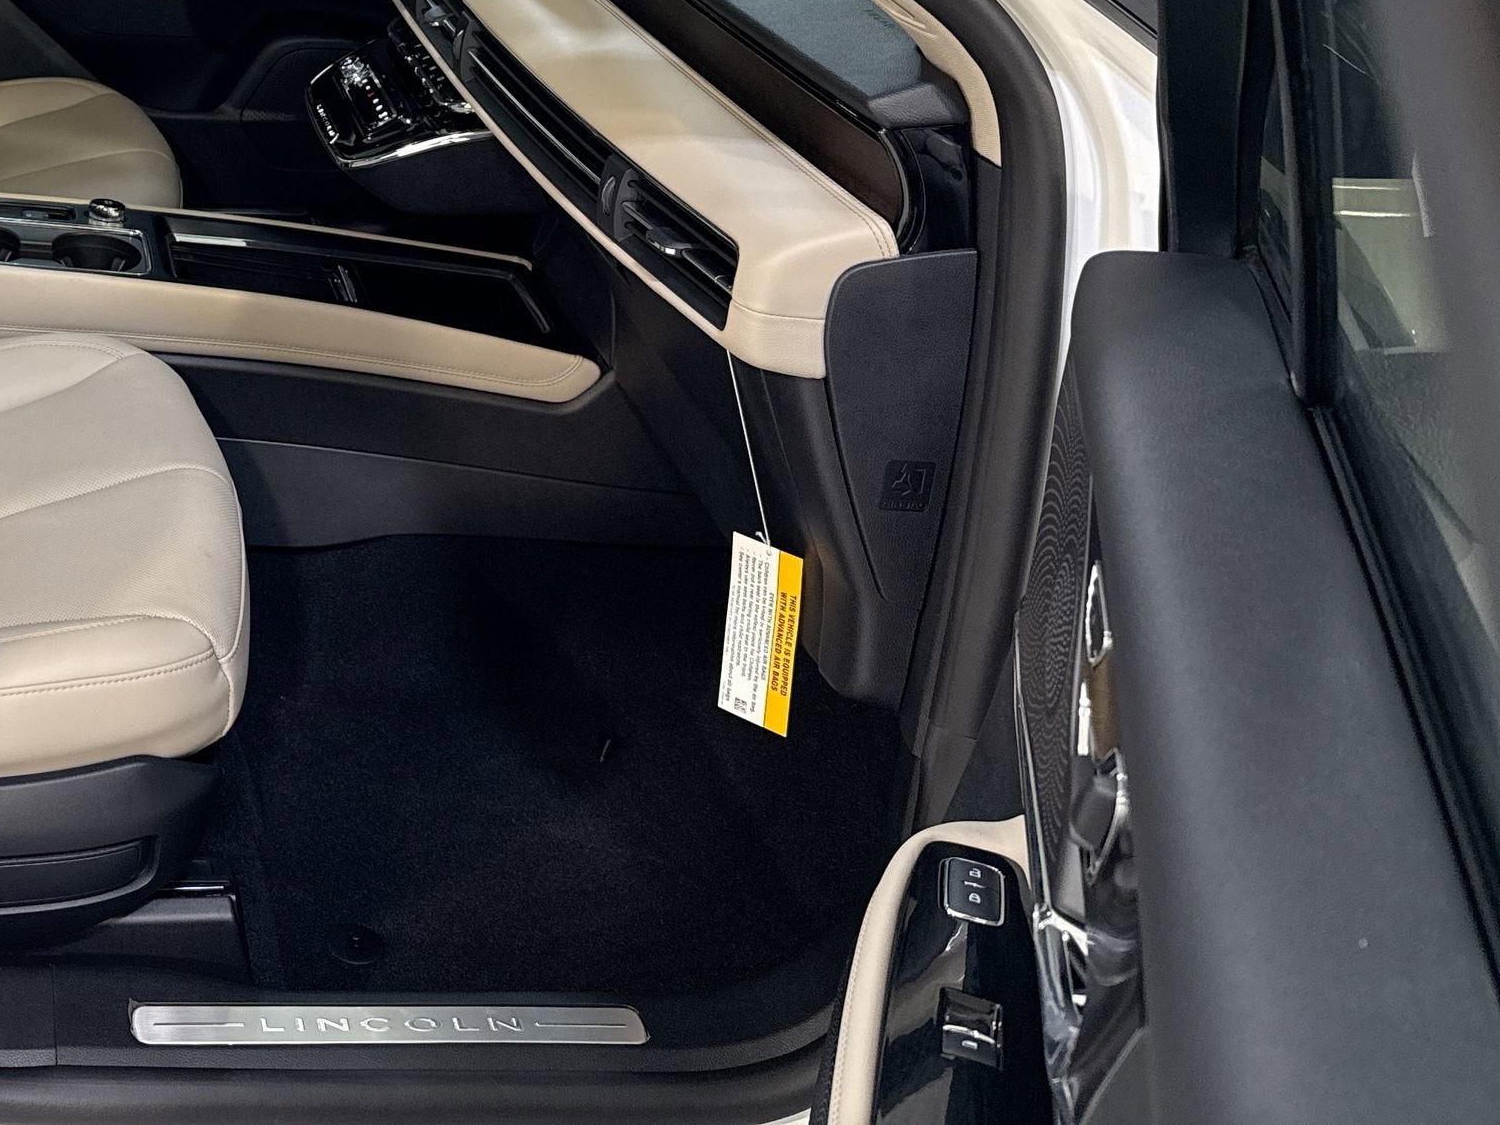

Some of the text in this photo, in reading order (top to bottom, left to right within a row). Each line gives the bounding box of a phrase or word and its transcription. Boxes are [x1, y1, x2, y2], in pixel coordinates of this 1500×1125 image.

[775, 613, 785, 654] ADVANCED
[786, 614, 795, 647] VEHICLE
[784, 648, 791, 656] IS
[771, 671, 779, 691] BAGS
[780, 658, 790, 696] EQUIPPED
[260, 1016, 524, 1033] LINCOLN
